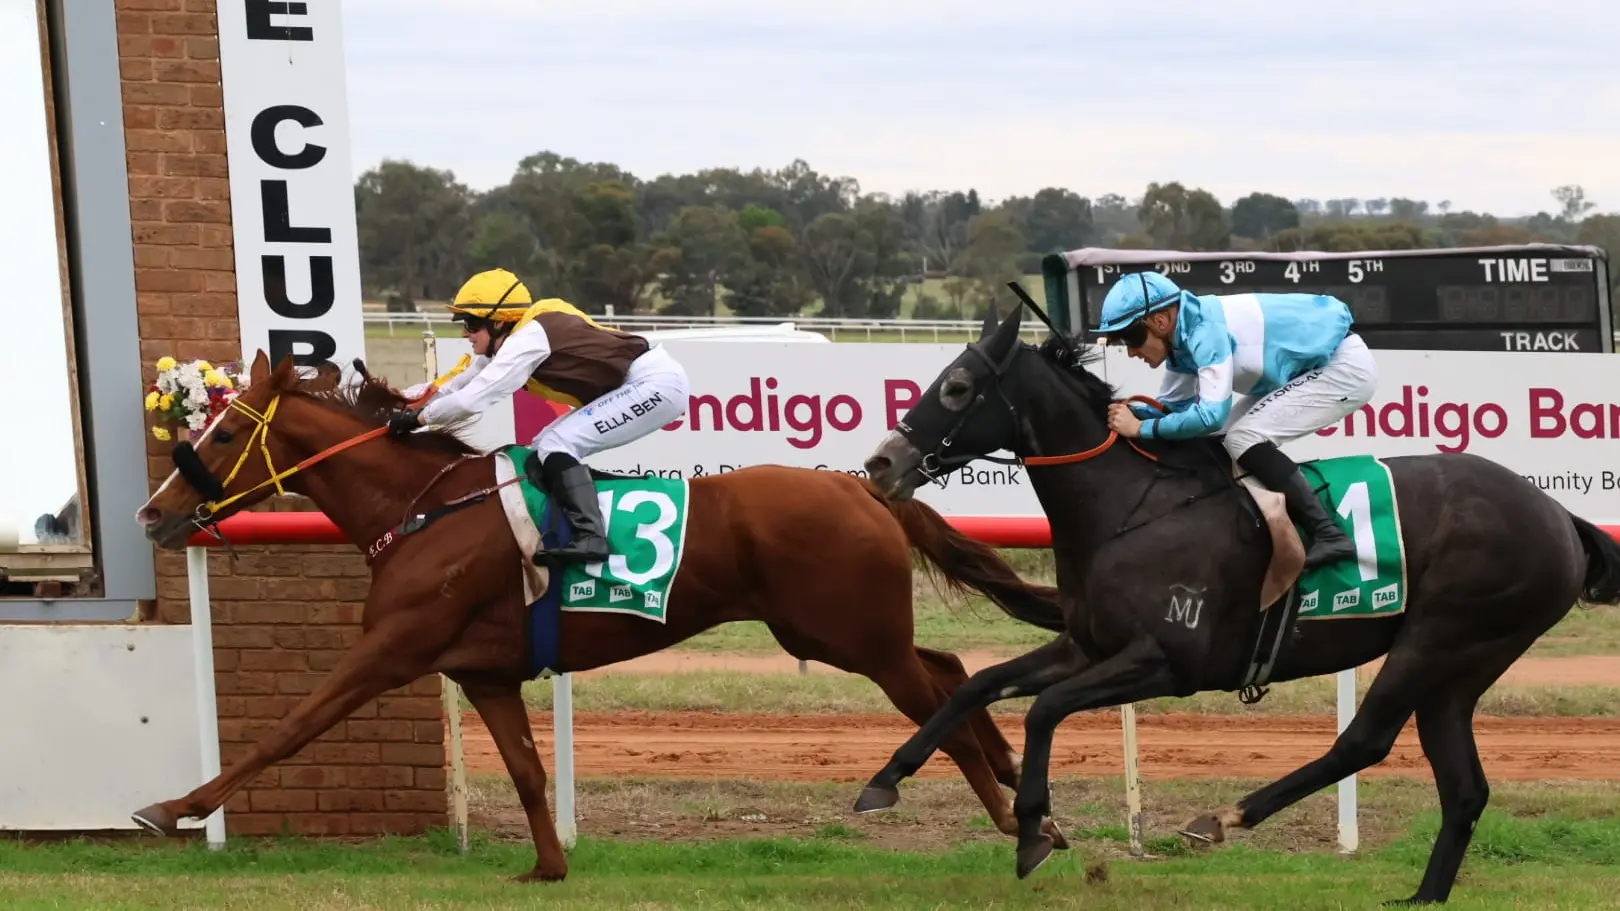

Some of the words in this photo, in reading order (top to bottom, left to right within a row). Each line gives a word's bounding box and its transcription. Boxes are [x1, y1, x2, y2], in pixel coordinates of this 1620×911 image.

[250, 105, 337, 382] CLUB
[1219, 261, 1256, 284] 3RD
[1284, 260, 1320, 283] 4TH
[1348, 259, 1384, 283] 5TH
[1478, 258, 1549, 282] TIME
[1500, 331, 1580, 351] TRACK
[594, 412, 633, 434] ELLA
[630, 391, 663, 417] BEN
[661, 377, 862, 449] ndigo
[1314, 385, 1508, 453] ndigo
[961, 465, 1020, 485] Bank
[1336, 481, 1379, 582] 1
[572, 586, 593, 596] TAB
[613, 587, 631, 598] TAB
[1300, 598, 1317, 608] AB
[1336, 595, 1357, 605] TAB
[1374, 591, 1396, 602] TAB
